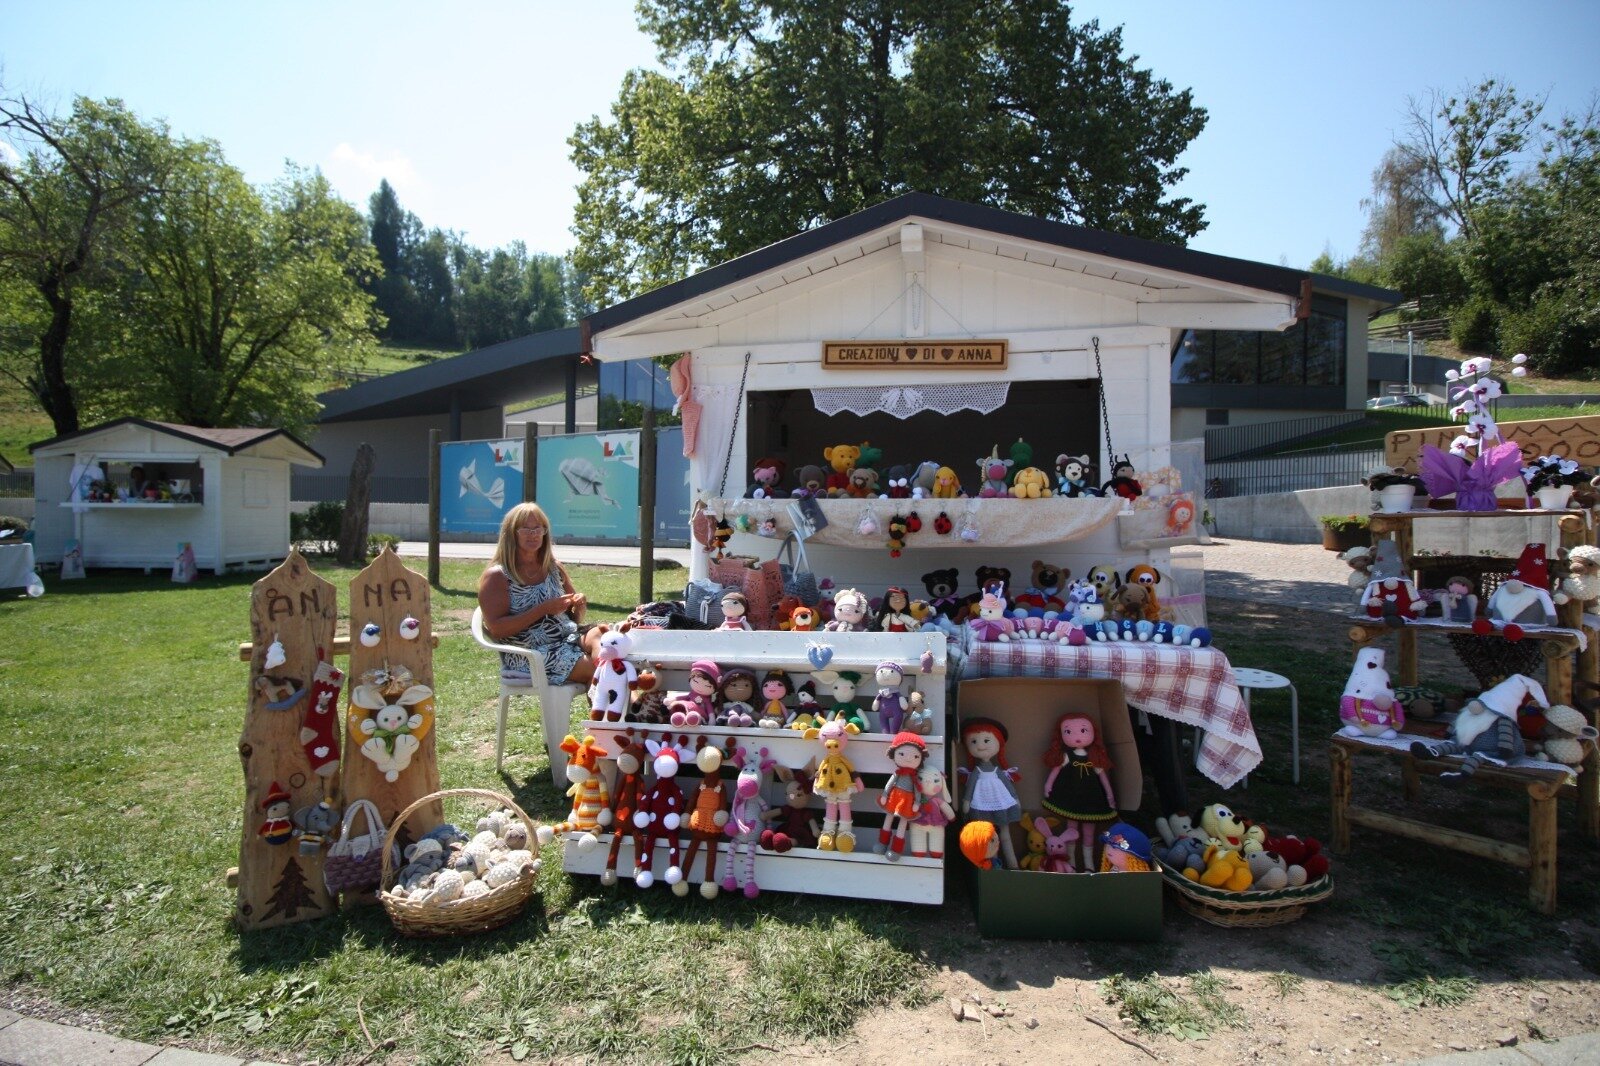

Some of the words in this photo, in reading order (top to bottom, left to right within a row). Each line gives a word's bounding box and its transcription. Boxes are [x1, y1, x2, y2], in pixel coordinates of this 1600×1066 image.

[922, 347, 936, 360] DI
[957, 348, 993, 361] ANNA
[363, 578, 412, 607] NA
